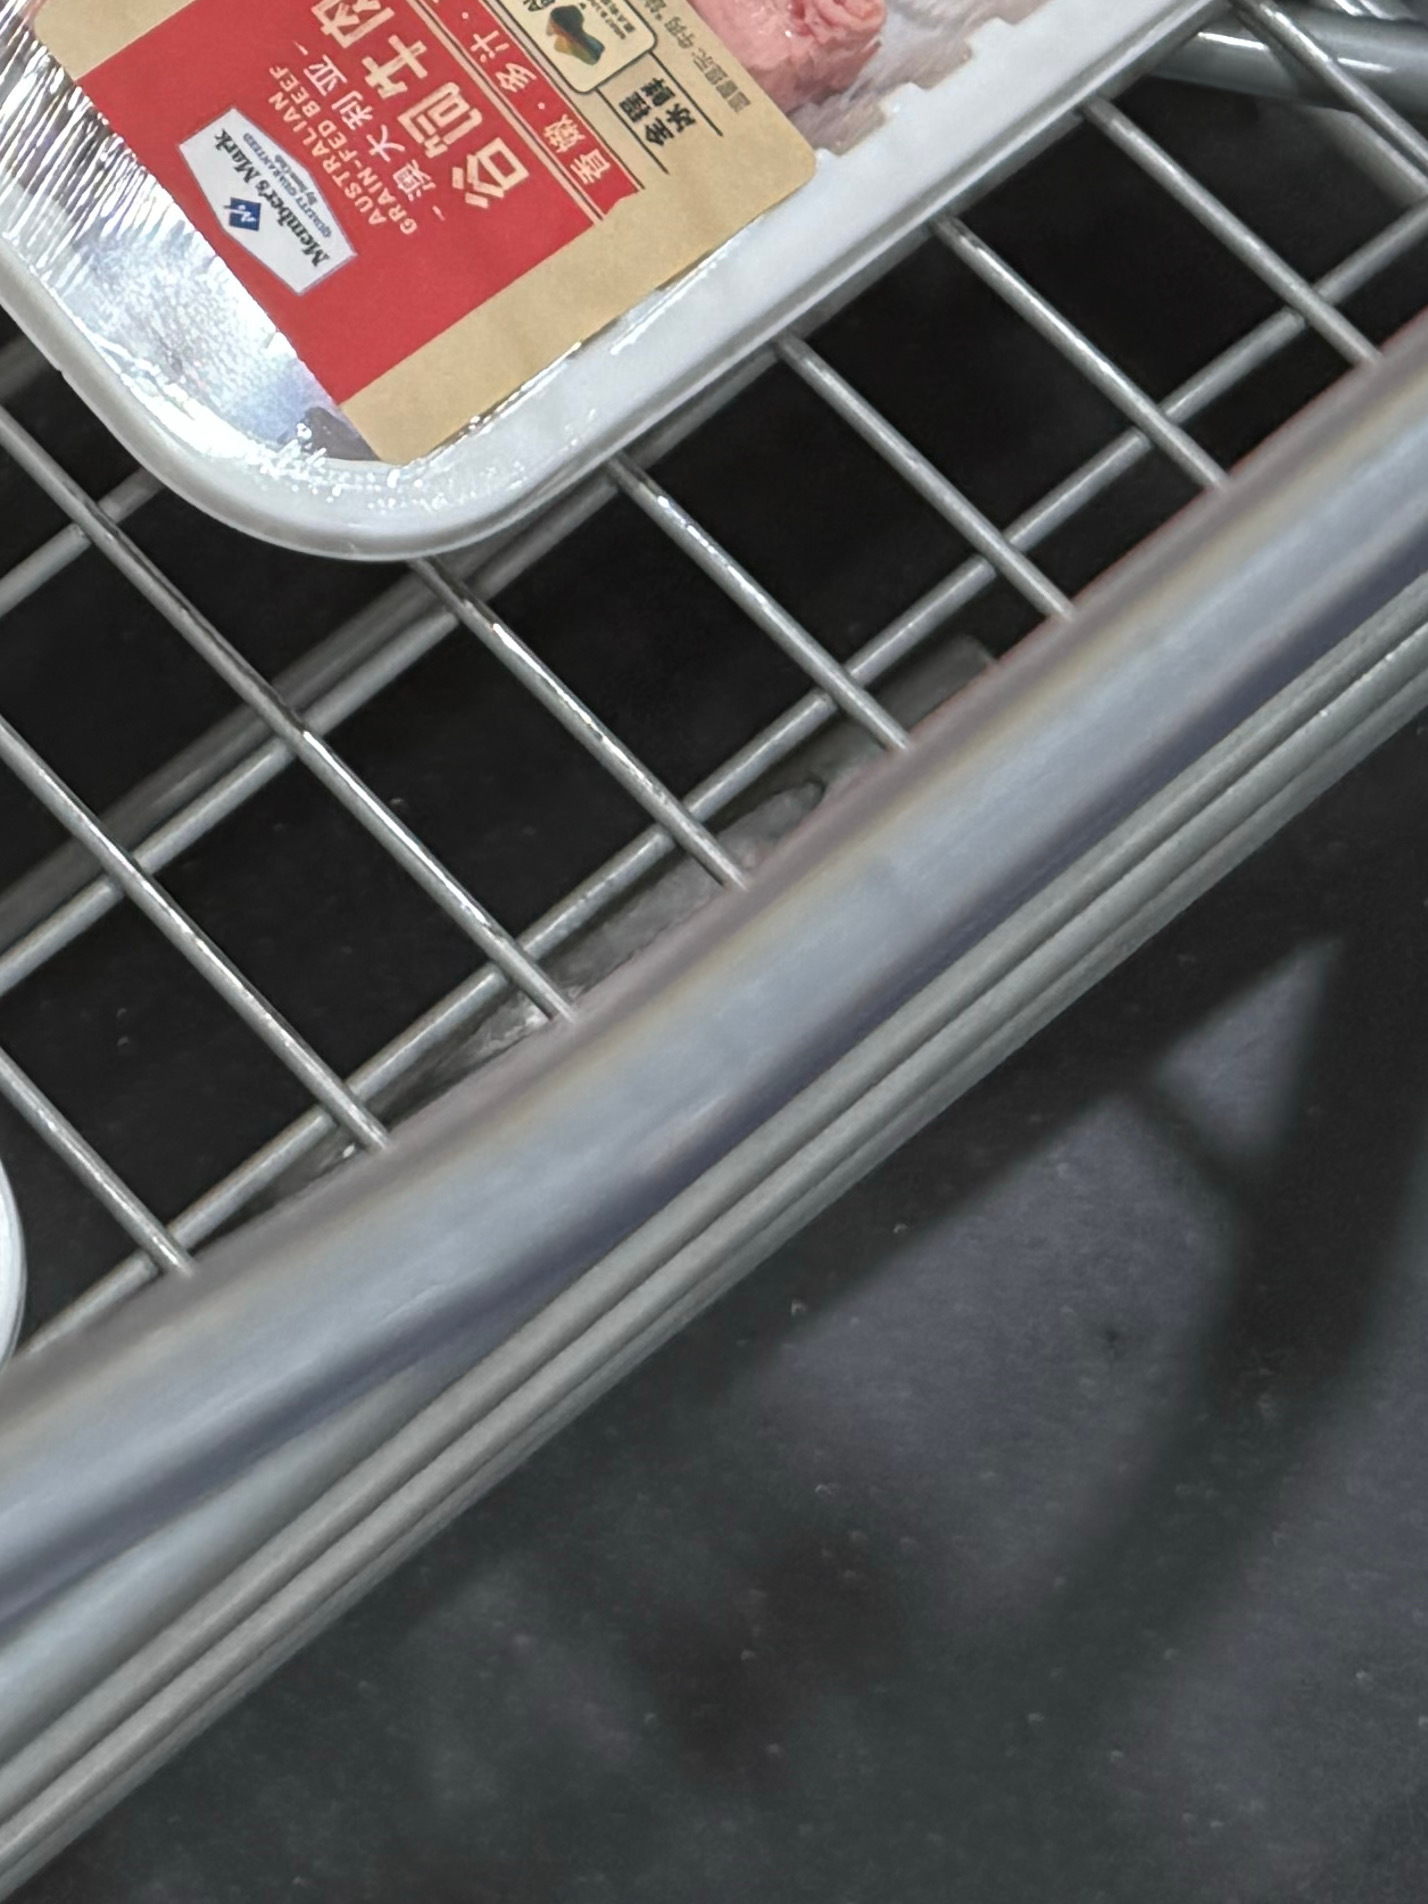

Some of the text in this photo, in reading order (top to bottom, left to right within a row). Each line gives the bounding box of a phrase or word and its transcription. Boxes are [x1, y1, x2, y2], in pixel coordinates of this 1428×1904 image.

[267, 90, 387, 225] AUSTRALIAN
[268, 66, 418, 235] GRAIN-FED BEEF
[617, 90, 675, 147] 全程
[639, 76, 697, 133] 冰鲜
[213, 128, 330, 268] Member's Mark
